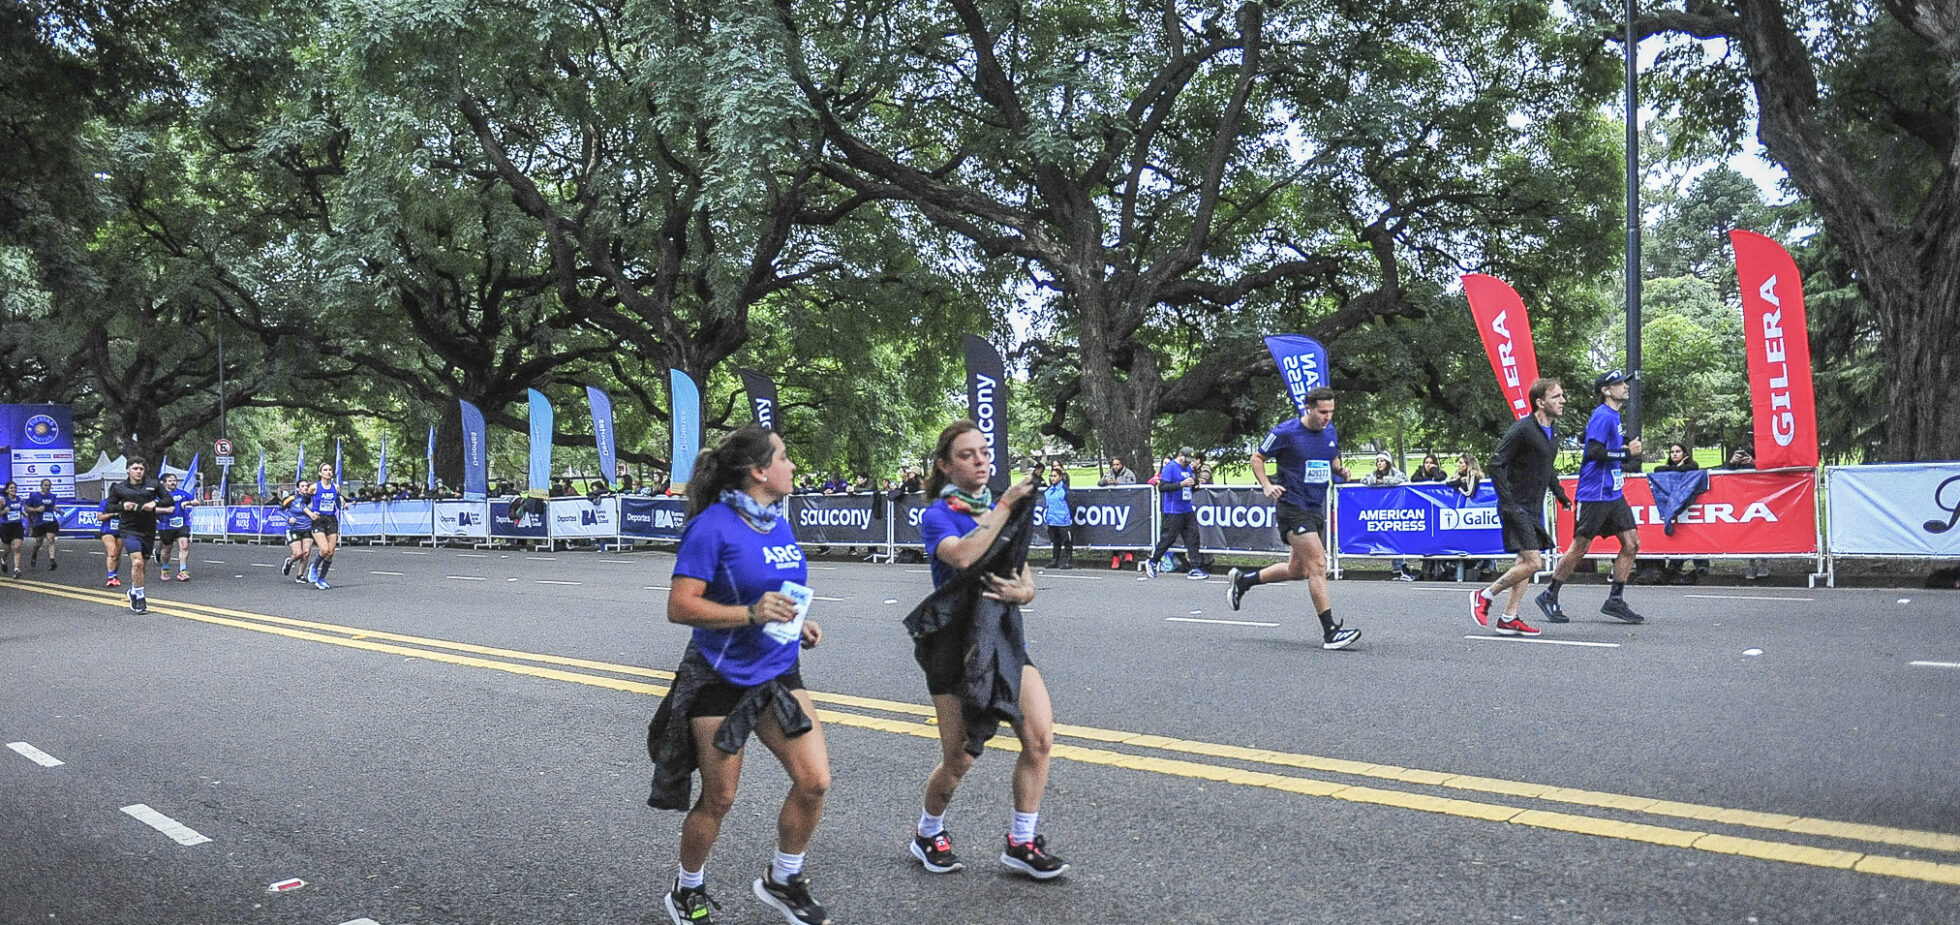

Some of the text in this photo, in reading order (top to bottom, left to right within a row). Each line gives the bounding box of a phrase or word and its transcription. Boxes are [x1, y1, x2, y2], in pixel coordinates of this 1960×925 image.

[1492, 309, 1531, 420] LERA
[1759, 274, 1796, 447] GILERA
[517, 511, 532, 528] A
[581, 509, 598, 526] BA
[627, 513, 650, 522] Deportes
[655, 510, 674, 528] BA
[800, 508, 872, 530] saucony
[1033, 505, 1130, 530] scony
[1192, 505, 1279, 528] aucon
[1358, 509, 1425, 521] AMERICAN
[1463, 511, 1502, 525] Galic
[1631, 502, 1779, 525] ILERA
[1367, 521, 1426, 532] EXPRESS
[762, 544, 802, 564] ARG
